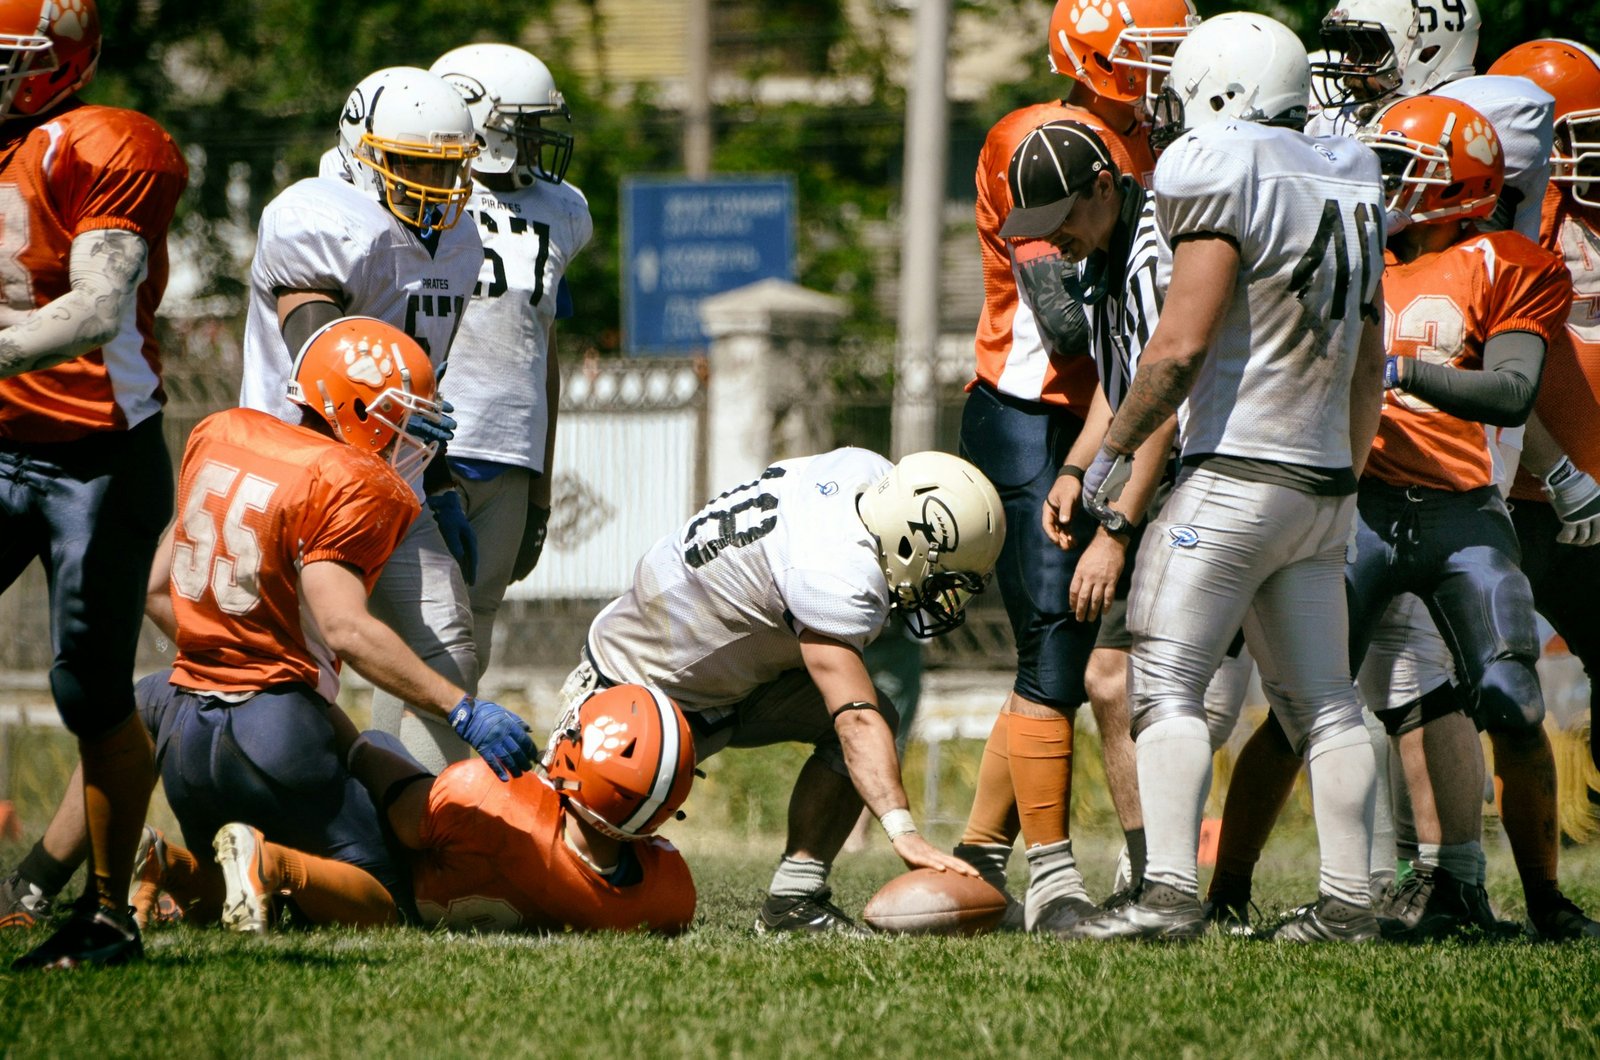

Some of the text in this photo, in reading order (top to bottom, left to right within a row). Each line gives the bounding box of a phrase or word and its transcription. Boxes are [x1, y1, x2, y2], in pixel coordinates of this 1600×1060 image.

[481, 197, 521, 213] PIRATES
[422, 278, 449, 290] PIRATES
[170, 458, 280, 616] 55
